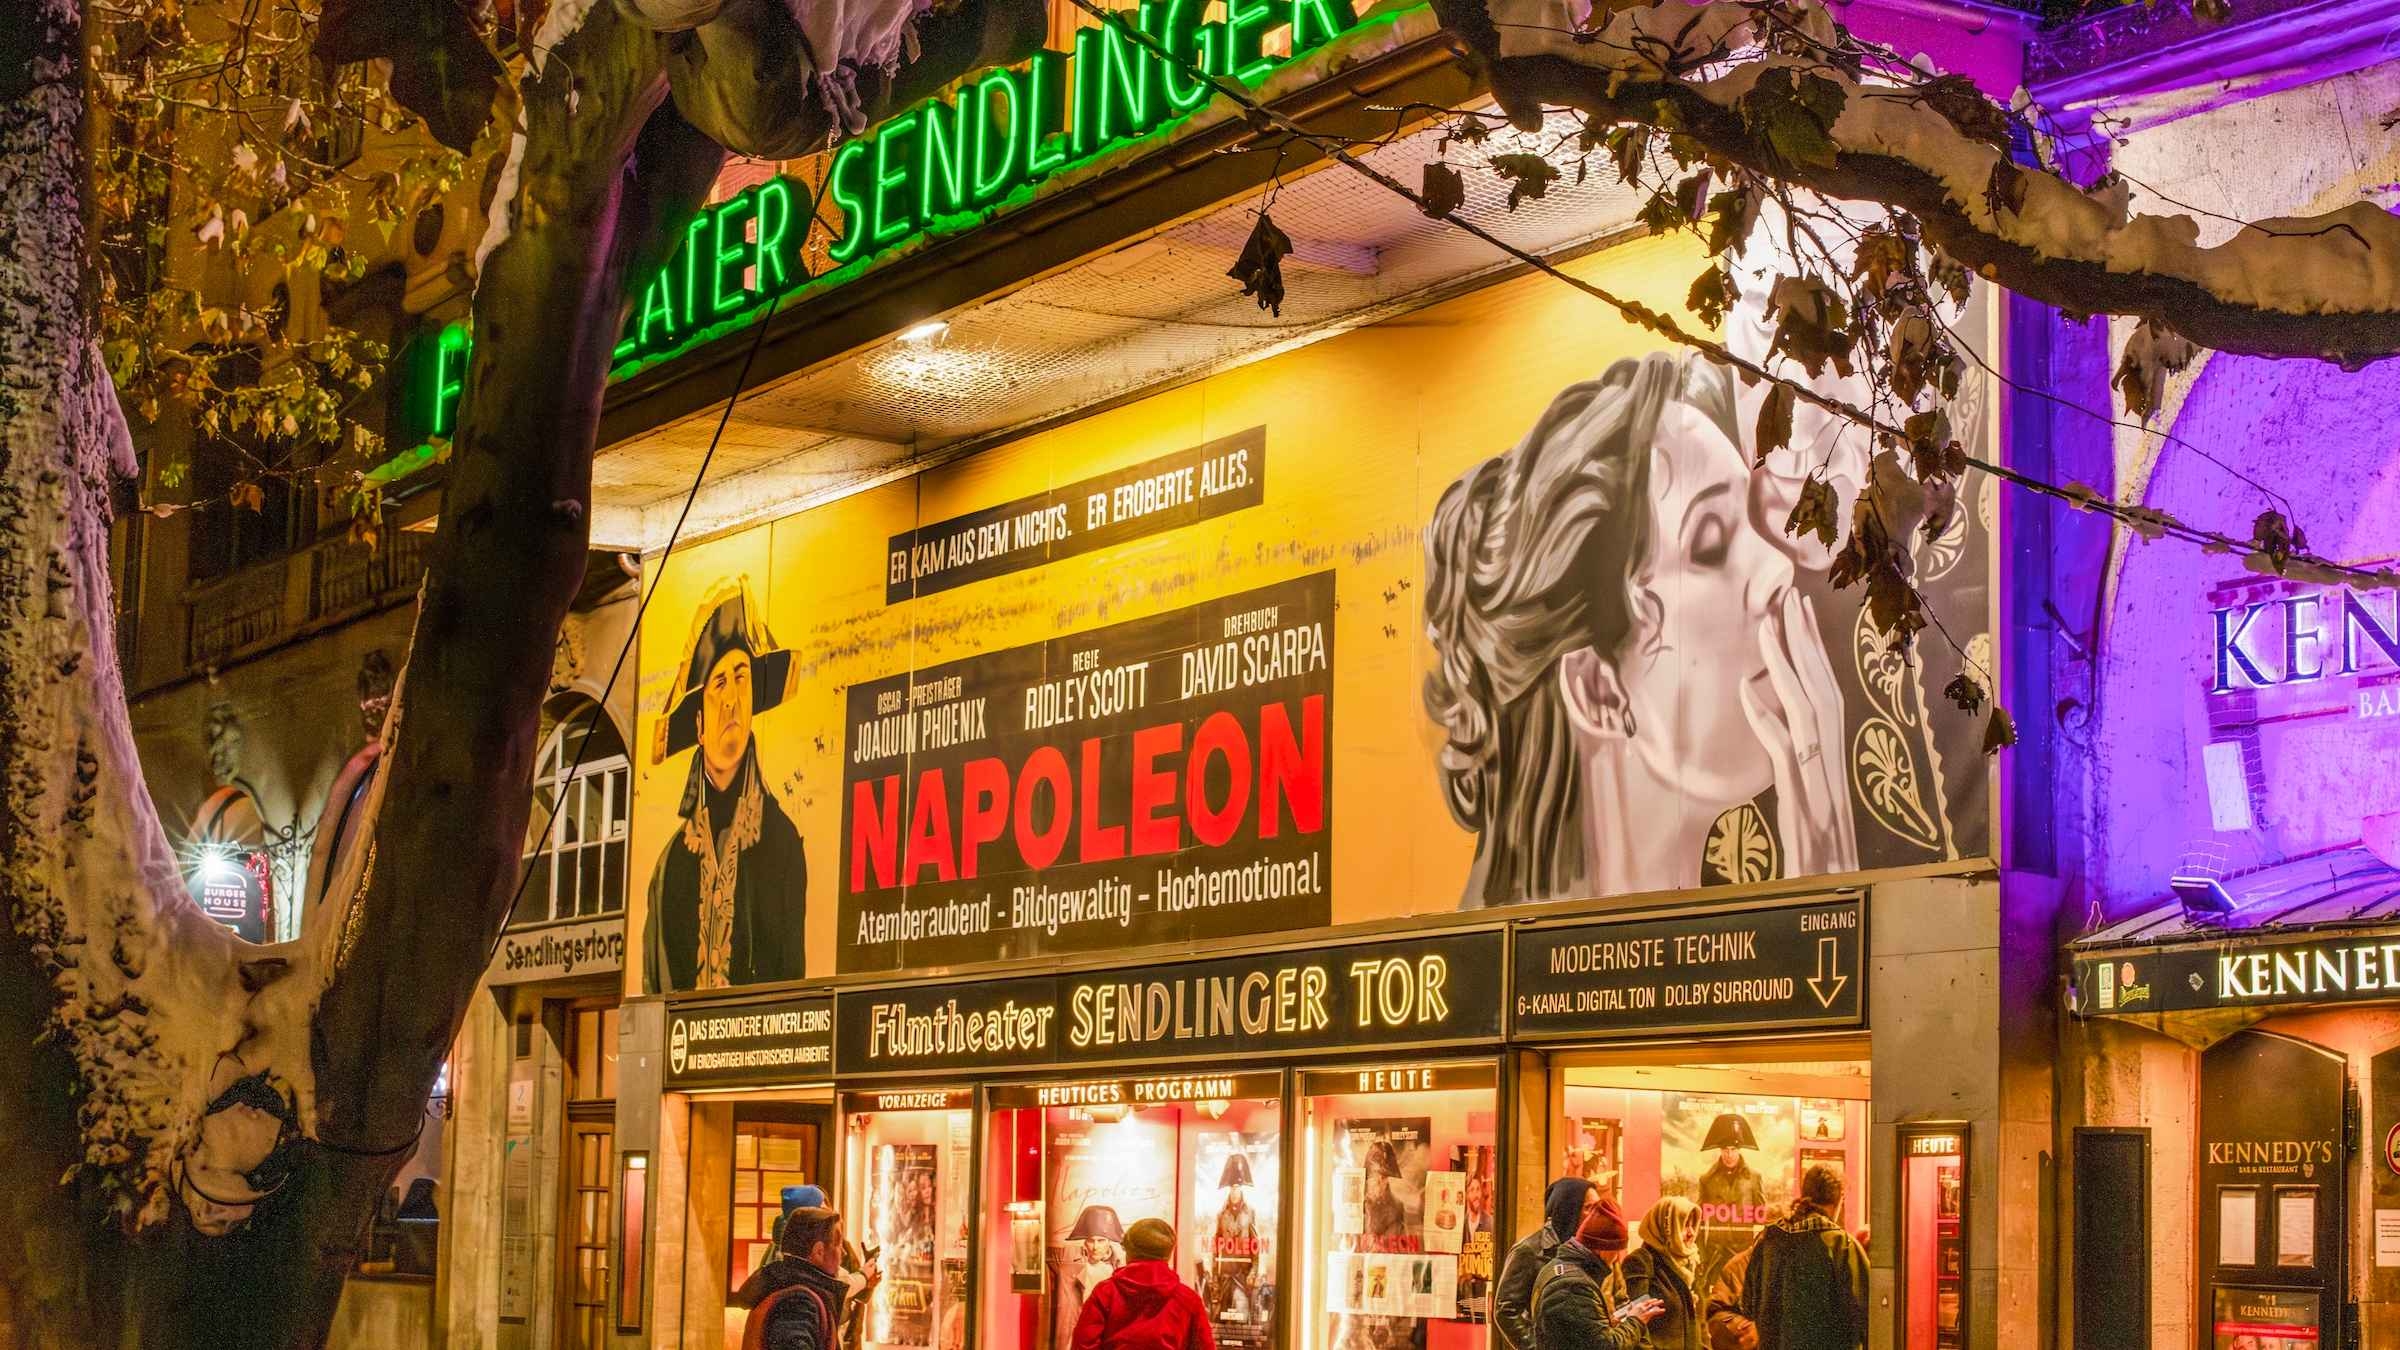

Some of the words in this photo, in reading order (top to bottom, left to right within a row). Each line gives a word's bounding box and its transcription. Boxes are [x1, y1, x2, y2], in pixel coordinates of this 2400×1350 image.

[890, 551, 907, 586] ER
[911, 543, 944, 580] KAM
[947, 527, 976, 570] AUS
[978, 521, 1009, 562] DEM
[1014, 503, 1071, 547] NICHTS.
[1087, 493, 1107, 532] ER
[1113, 467, 1195, 524] EROBERTE
[1200, 448, 1254, 497] ALLES.
[1223, 606, 1279, 639] DREHBUCH
[1072, 648, 1100, 673] REGIE
[1181, 641, 1239, 700] DAVID
[1243, 622, 1327, 686] SCARPA
[877, 690, 901, 715] OSCAR
[912, 676, 962, 708] PREISTRÄGER
[1025, 668, 1087, 731] RIDLEY
[1089, 661, 1150, 720] SCOTT
[2358, 687, 2400, 720] BA
[853, 712, 917, 764] JOAQUIN
[921, 697, 986, 751] PHOENIX
[850, 694, 1325, 894] NAPOLEON
[203, 897, 247, 908] HOUSE
[204, 887, 247, 898] BURGER
[857, 892, 991, 945] Atemberaubend
[1012, 875, 1132, 937] Bildgewaltig
[1157, 851, 1322, 912] Hochemotional
[1800, 911, 1857, 932] EINGANG
[1550, 938, 1664, 975] MODERNSTE
[1673, 931, 1757, 966] TECHNIK
[869, 1000, 1055, 1059] Filmtheater
[1070, 965, 1329, 1047] SENDLINGER
[1350, 955, 1450, 1028] TOR
[1517, 991, 1574, 1016] 6-KANAL
[1577, 988, 1627, 1012] DIGITAL
[1628, 986, 1656, 1009] TON
[1664, 982, 1710, 1007] DOLBY
[1712, 977, 1794, 1004] SURROUND
[689, 1019, 708, 1041] DAS
[708, 1015, 762, 1040] BESONDERE
[762, 1009, 831, 1036] KINOERLEBNIS
[744, 1047, 794, 1067] HISTORISCHEN
[794, 1046, 830, 1063] AMBIENTE
[1038, 1084, 1120, 1106] HEUTIGES
[1135, 1079, 1232, 1101] PROGRAMM
[1359, 1069, 1432, 1092] HEUTE
[878, 1093, 947, 1110] VORANZEIGE
[1911, 1137, 1954, 1154] HEUTE
[2208, 1140, 2332, 1164] KENNEDY'S
[1702, 1203, 1767, 1224] POLEO
[1200, 1236, 1270, 1255] NAPOLEON
